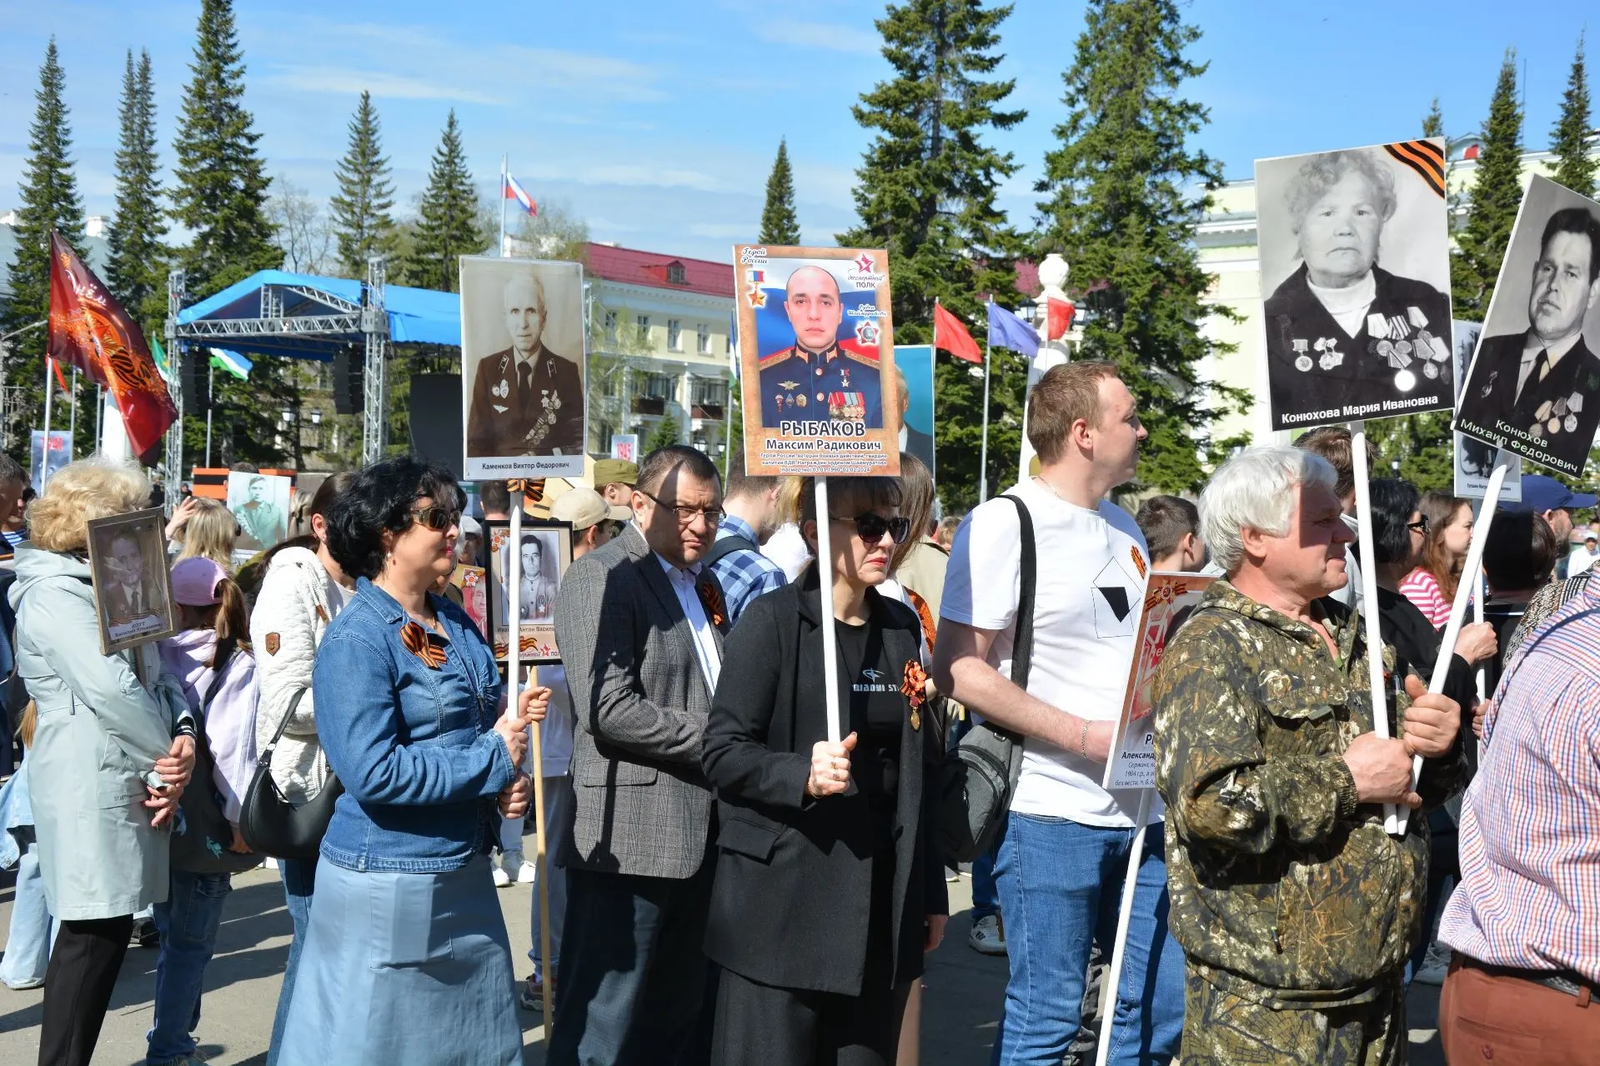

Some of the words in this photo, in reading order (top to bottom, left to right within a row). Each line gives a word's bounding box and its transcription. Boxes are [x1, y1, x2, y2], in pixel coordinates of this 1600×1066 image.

[856, 281, 876, 289] ПОЛК
[1281, 407, 1341, 424] Конюхова
[1342, 402, 1381, 417] Мария
[1382, 395, 1439, 411] Ивановна
[781, 421, 866, 437] РЫБАКОВ
[1495, 419, 1549, 448] Конюхов
[766, 439, 814, 450] Максим
[816, 439, 881, 452] Радикович
[1460, 418, 1508, 445] Михаил
[1510, 440, 1579, 473] Федорович
[513, 462, 535, 470] Виктор
[536, 462, 570, 470] Федорович
